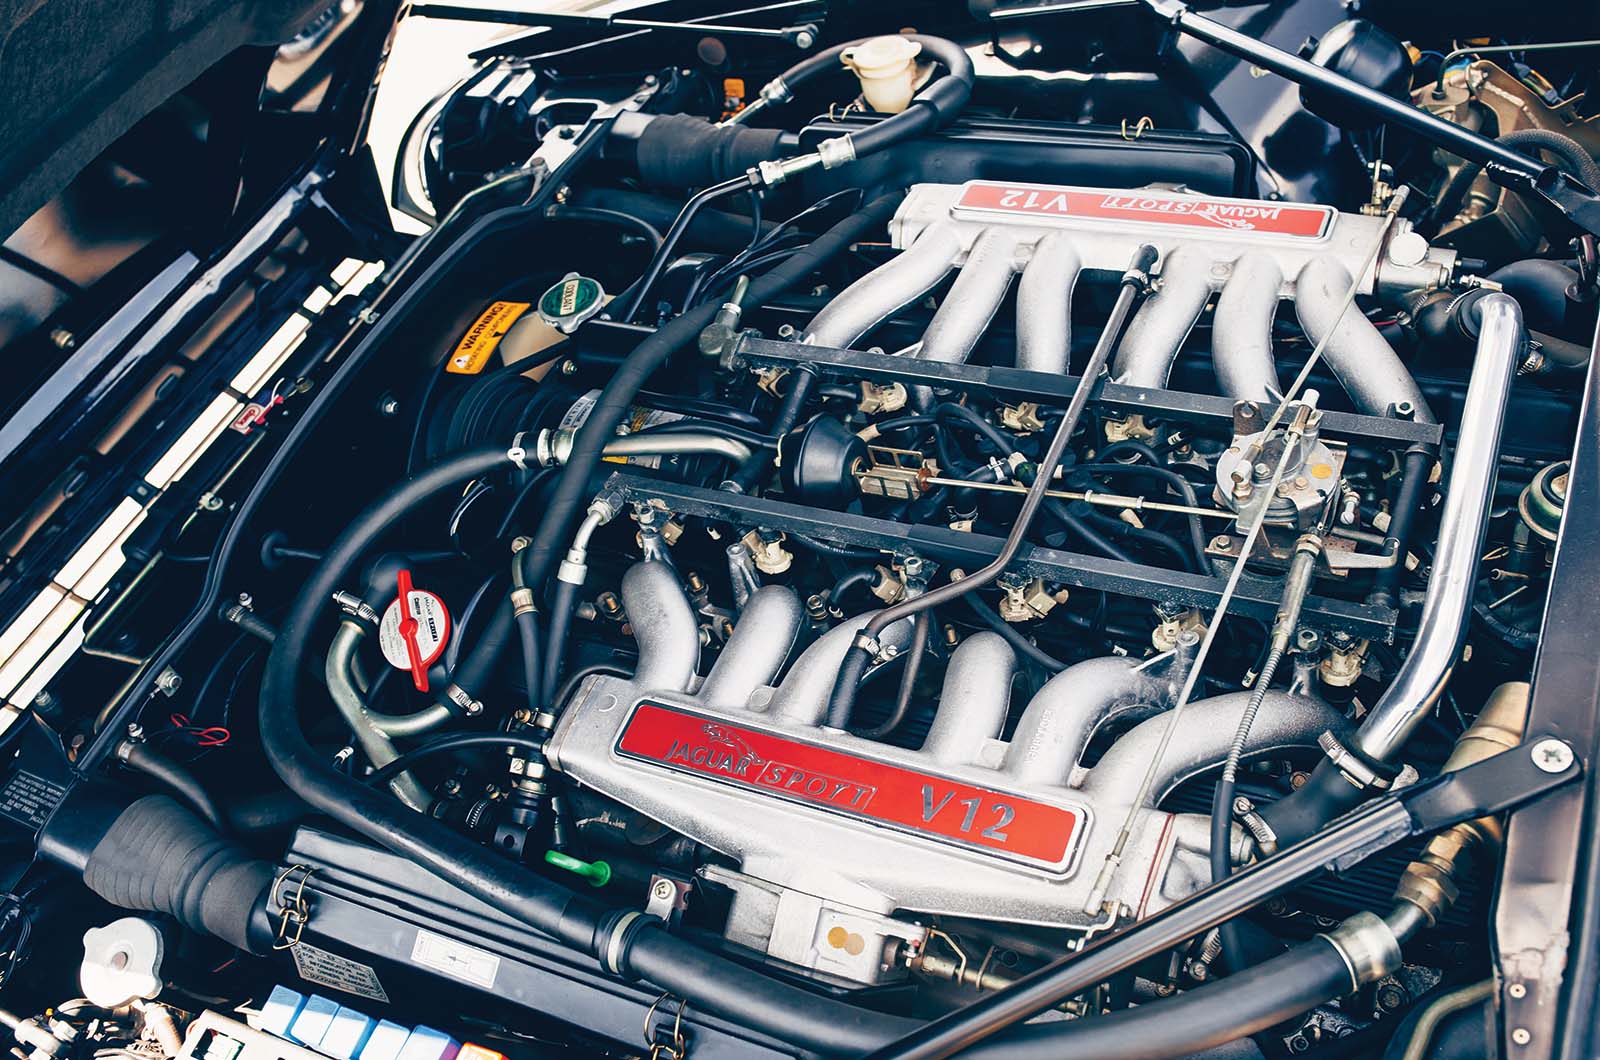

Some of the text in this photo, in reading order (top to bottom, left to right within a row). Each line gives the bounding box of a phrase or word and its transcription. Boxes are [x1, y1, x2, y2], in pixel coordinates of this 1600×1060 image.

[1000, 189, 1069, 212] V12
[1205, 203, 1282, 221] JAGUAR
[562, 284, 575, 311] COOLANT
[462, 303, 505, 350] WARNING!
[665, 739, 750, 777] JAGUAR
[921, 783, 1016, 842] V12
